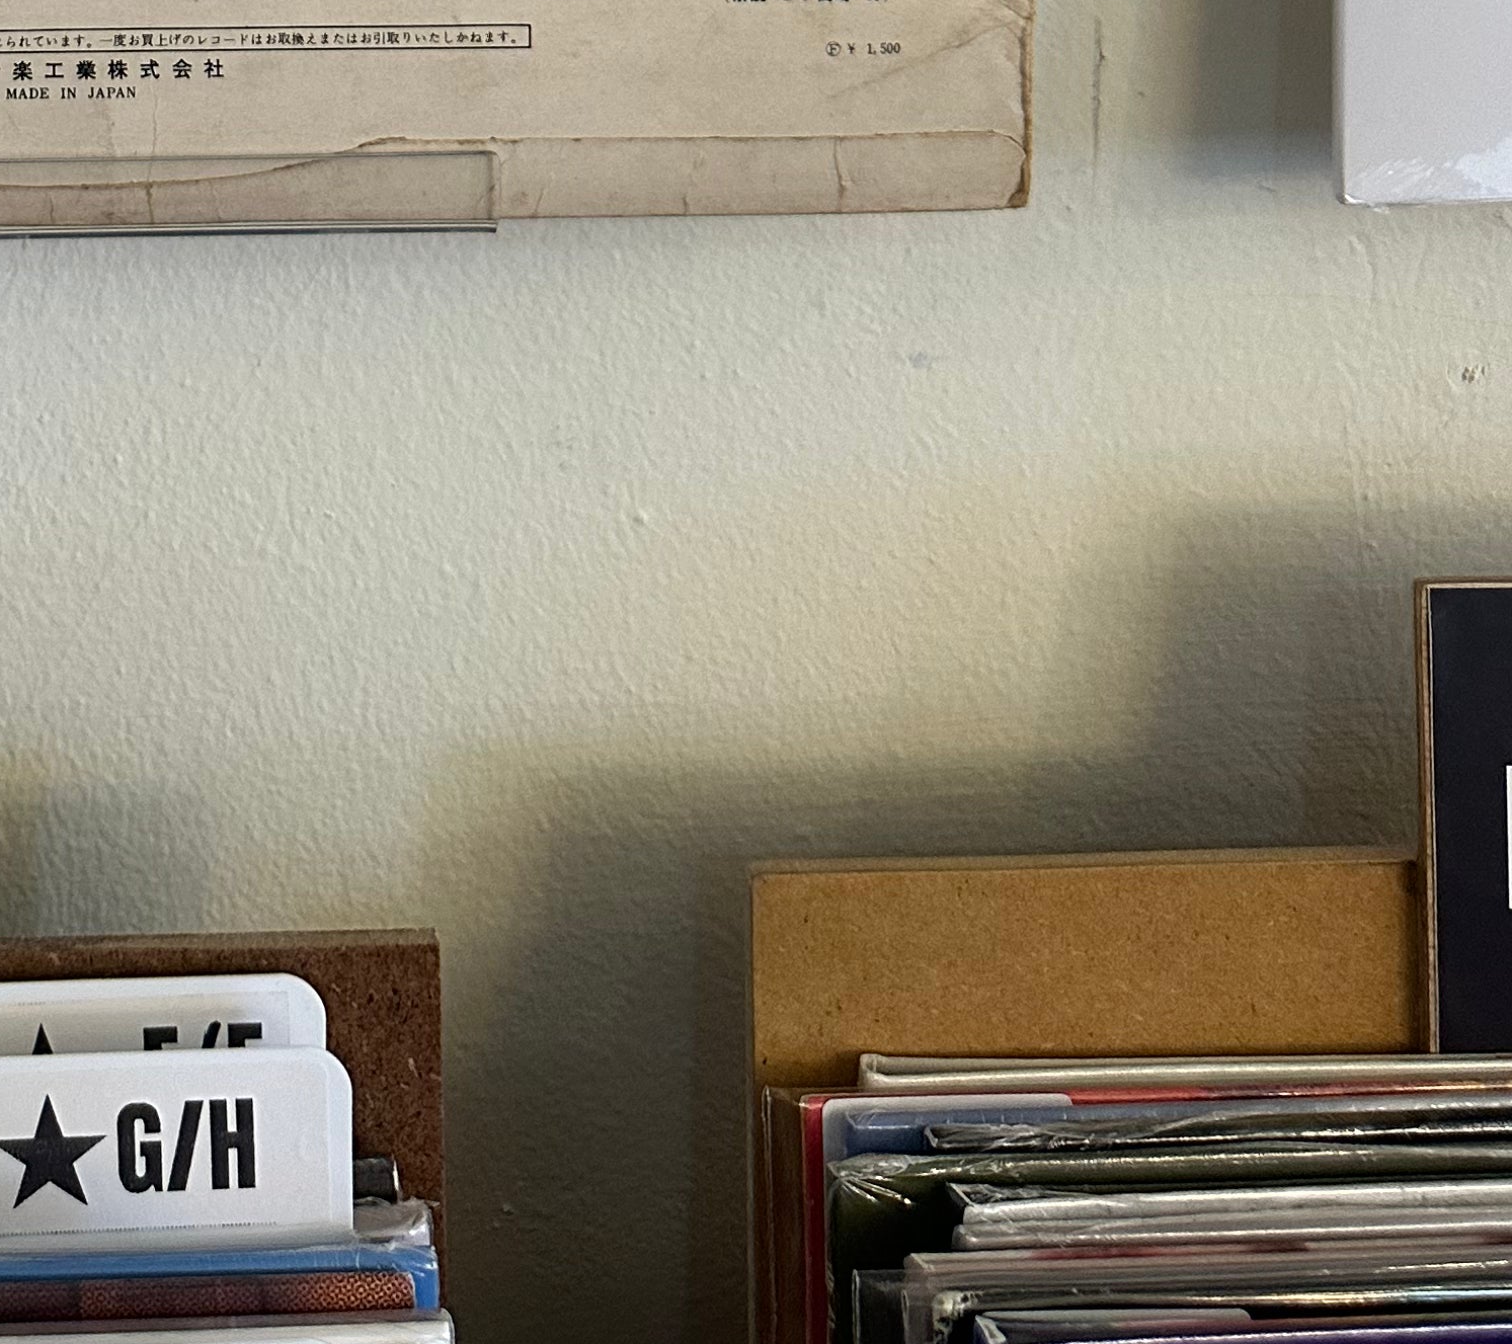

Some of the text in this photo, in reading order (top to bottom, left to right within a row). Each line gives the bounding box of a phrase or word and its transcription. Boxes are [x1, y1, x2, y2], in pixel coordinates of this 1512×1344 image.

[6, 85, 138, 100] MADE IN JAPAN
[116, 1097, 258, 1194] G/H
